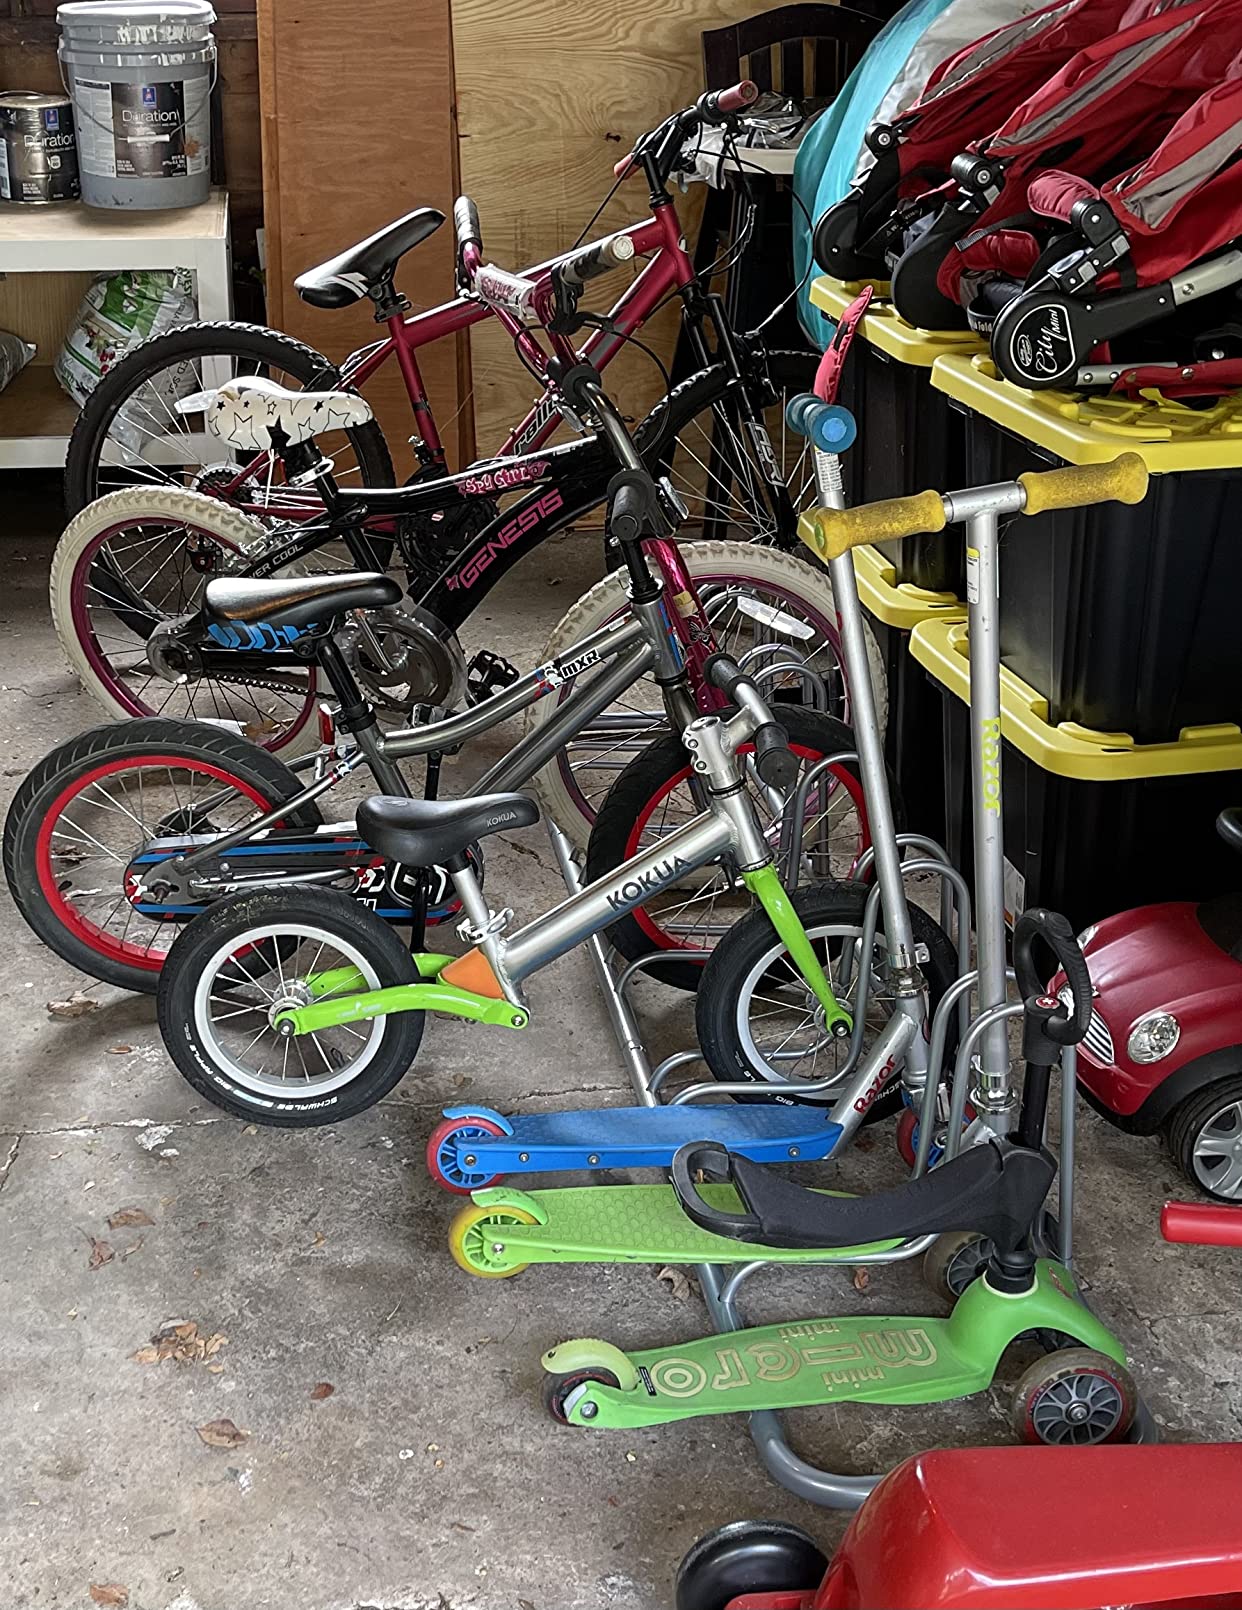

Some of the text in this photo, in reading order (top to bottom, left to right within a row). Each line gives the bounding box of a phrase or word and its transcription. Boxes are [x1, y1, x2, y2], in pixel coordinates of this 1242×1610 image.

[1036, 326, 1067, 374] City
[272, 544, 304, 565] COOL
[459, 488, 564, 589] GENESIS
[981, 717, 1000, 818] Razor
[486, 811, 517, 828] KOKUA
[606, 855, 693, 912] KOKUA
[853, 1053, 896, 1114] Razor
[276, 1096, 338, 1111] SCHWALBE
[778, 1322, 841, 1343] mini
[821, 1366, 887, 1392] mini
